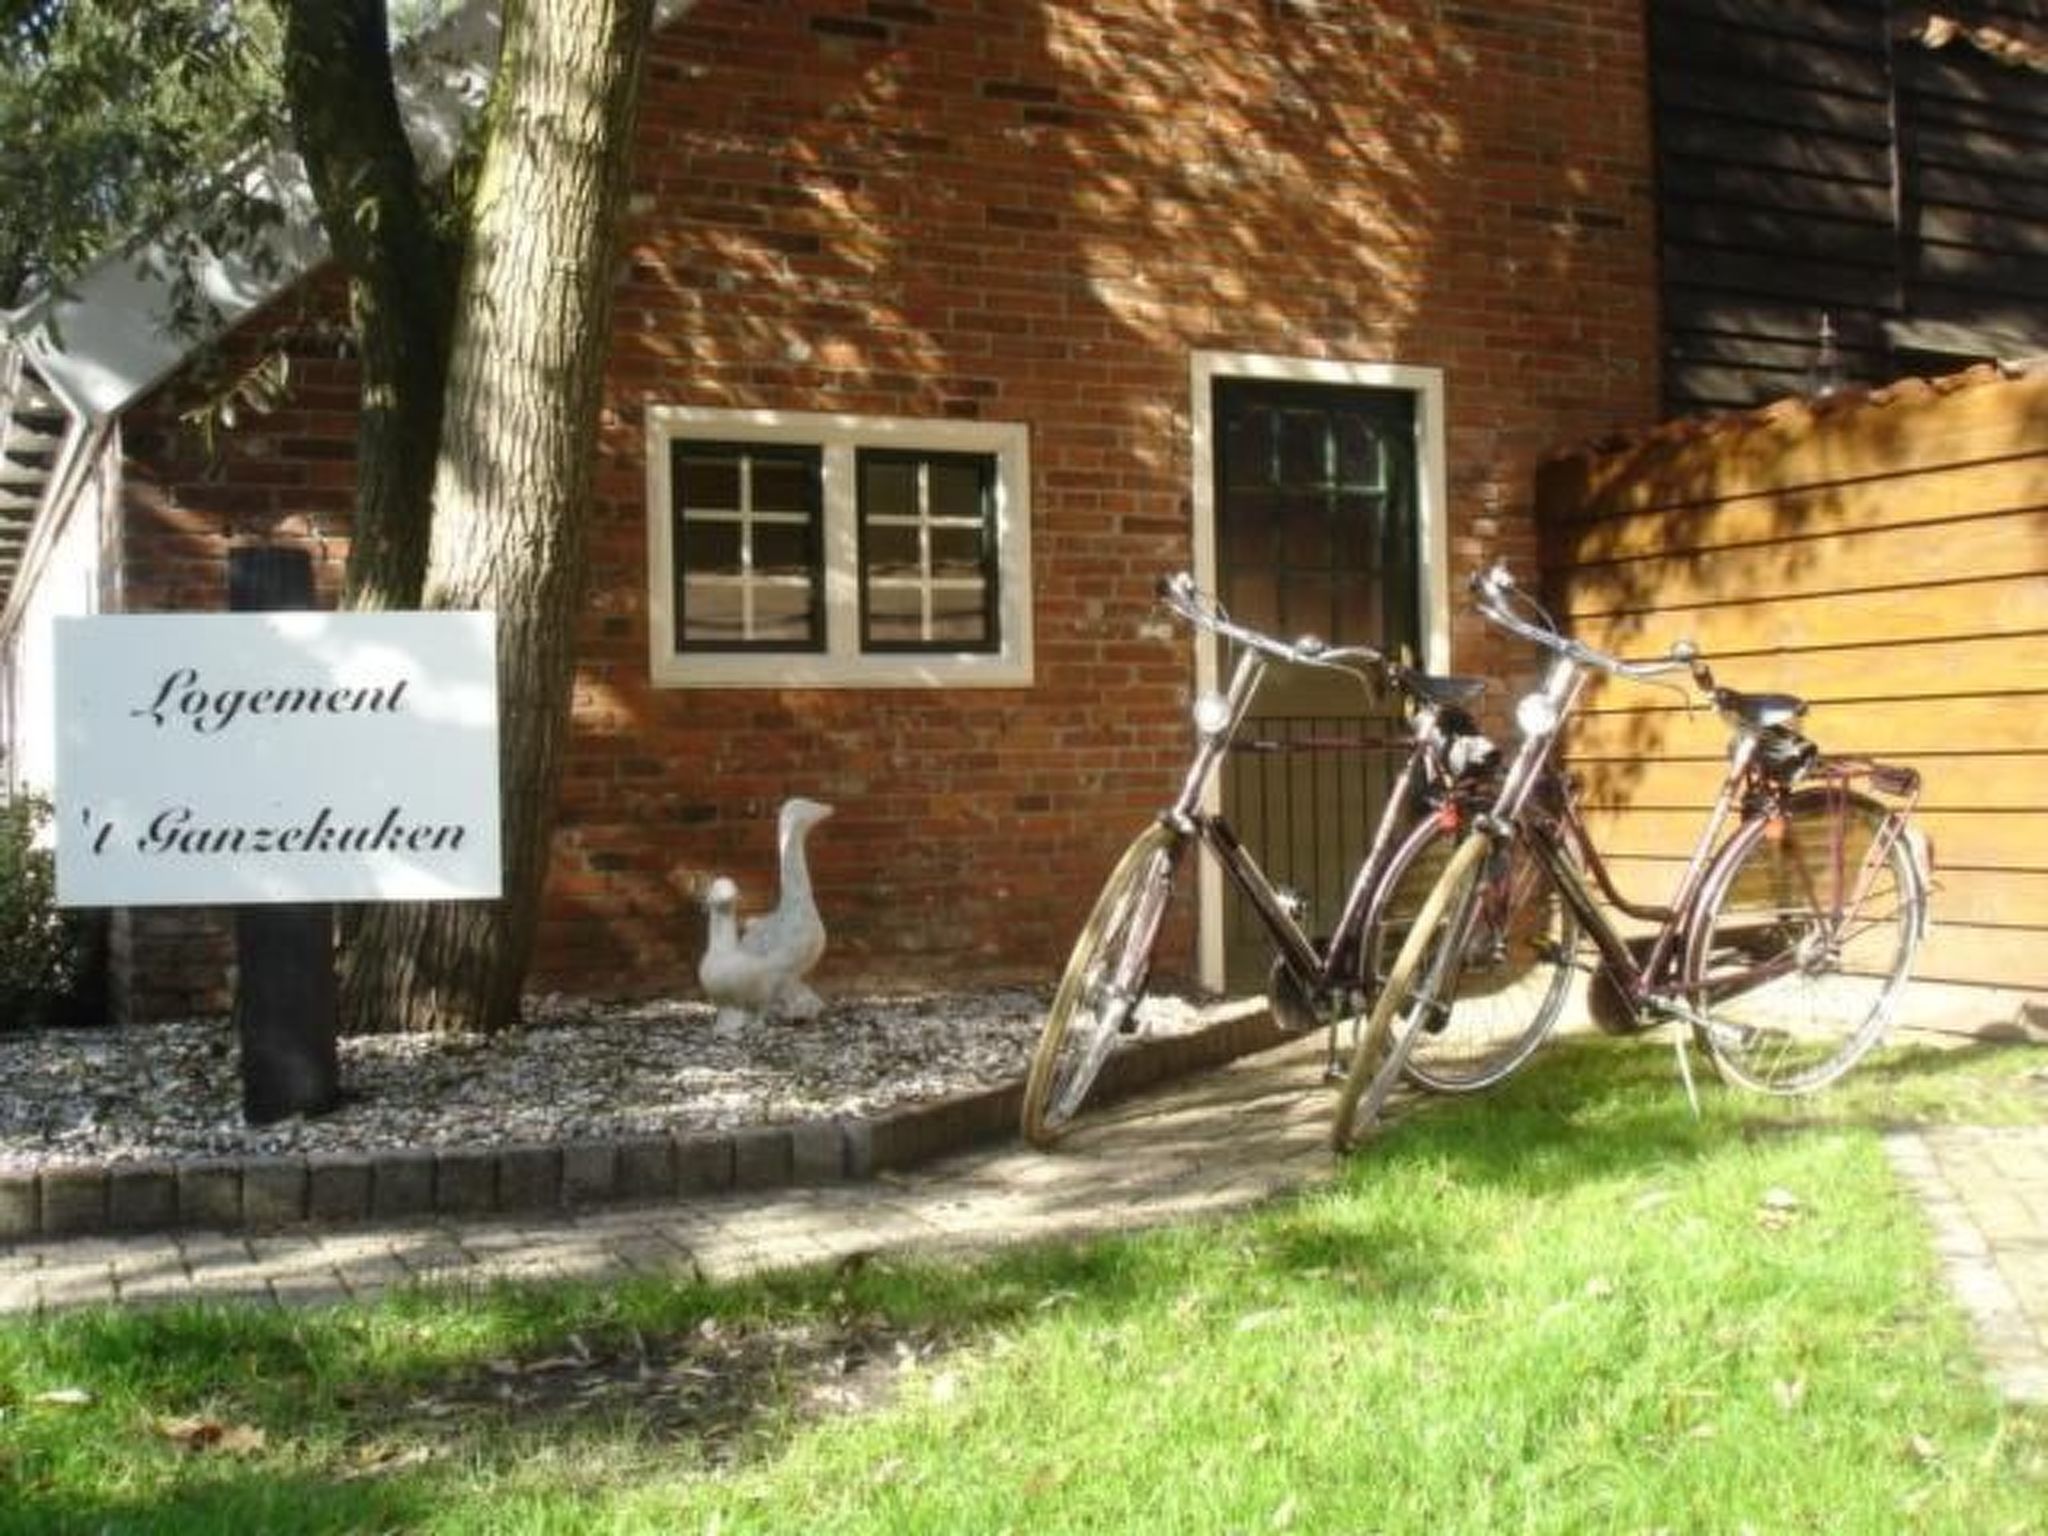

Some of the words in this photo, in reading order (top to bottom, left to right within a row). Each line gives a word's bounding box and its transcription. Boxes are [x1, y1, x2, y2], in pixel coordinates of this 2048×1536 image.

[130, 668, 408, 733] Logement
[81, 807, 113, 855] 't
[137, 806, 466, 854] Ganzekuken
